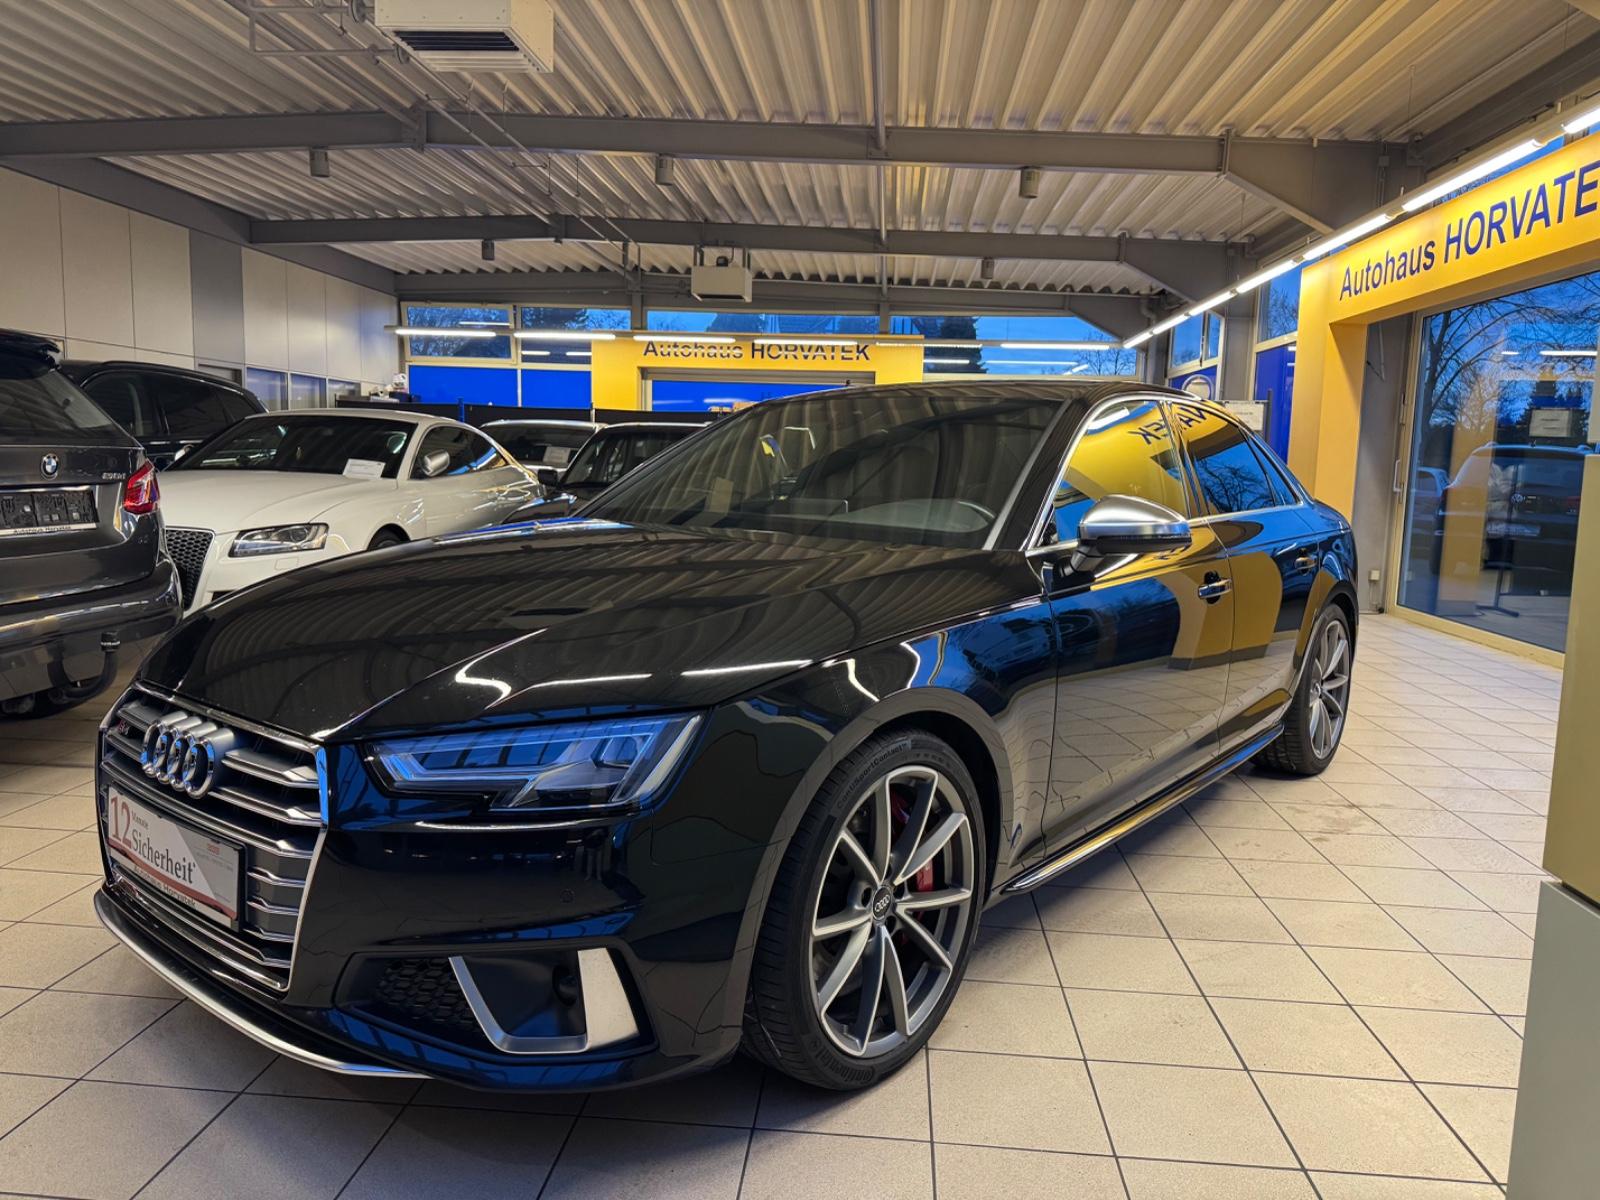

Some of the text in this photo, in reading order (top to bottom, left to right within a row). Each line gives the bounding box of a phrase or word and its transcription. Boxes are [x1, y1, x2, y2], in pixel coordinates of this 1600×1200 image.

[1339, 159, 1600, 301] Autohaus HORVATE
[643, 340, 870, 361] Autohaus HORVATEK
[110, 796, 132, 849] 12
